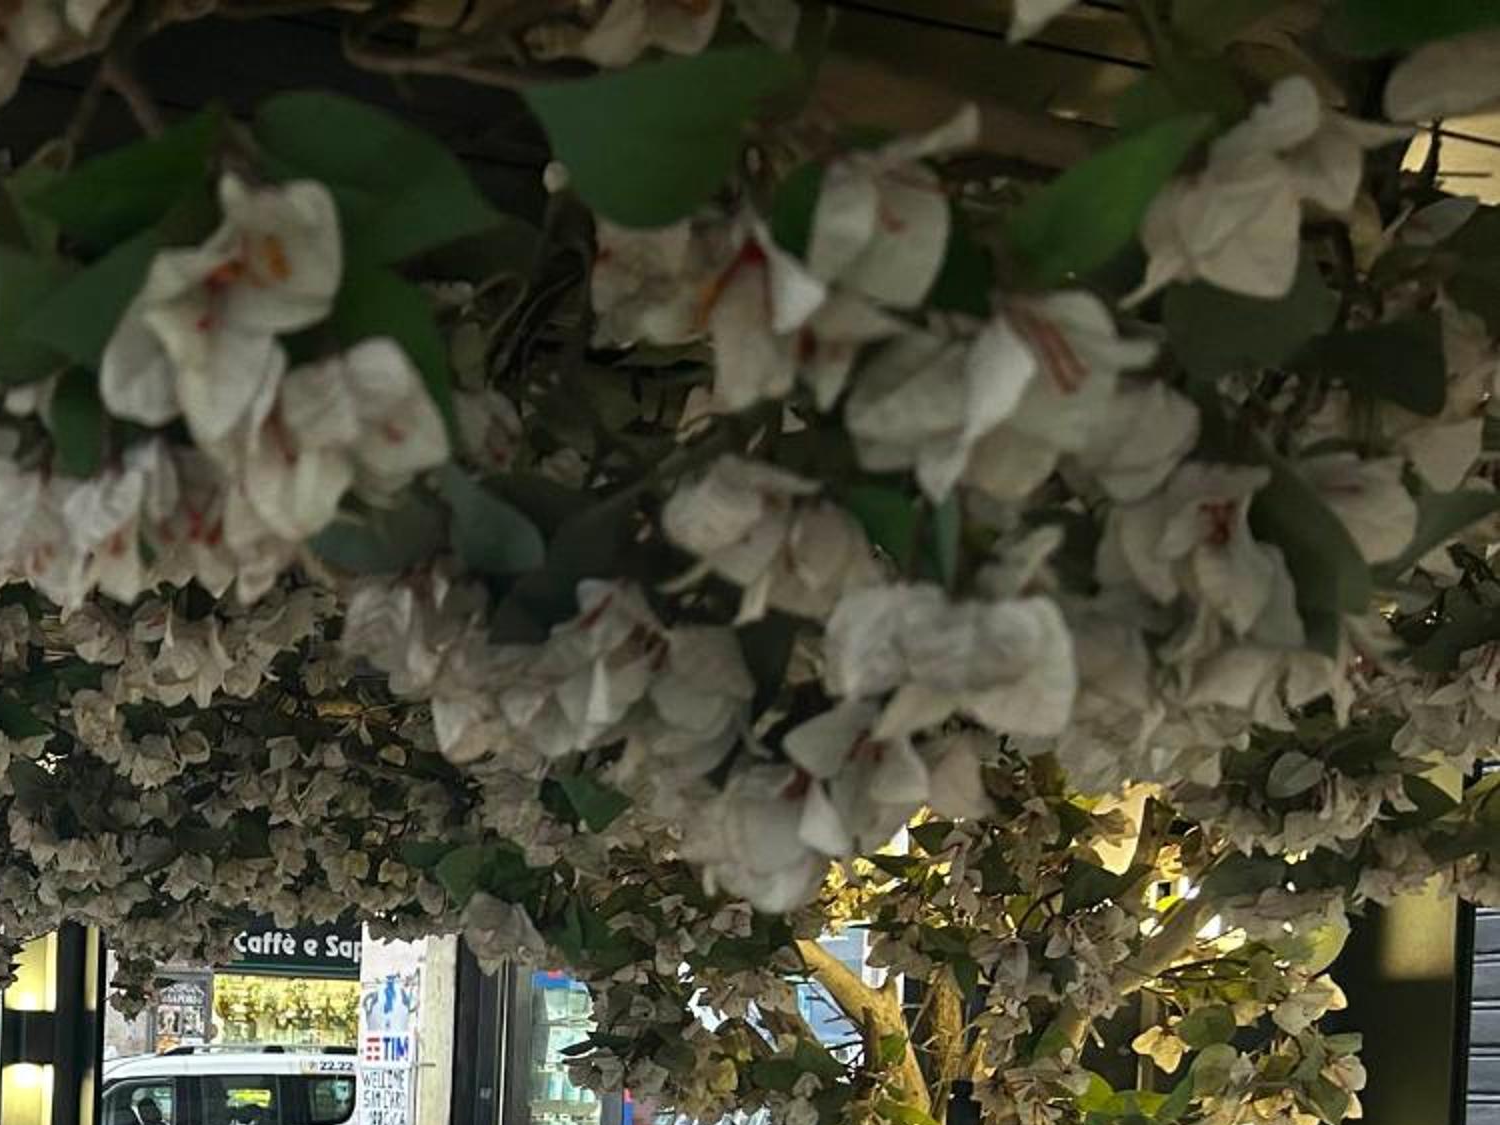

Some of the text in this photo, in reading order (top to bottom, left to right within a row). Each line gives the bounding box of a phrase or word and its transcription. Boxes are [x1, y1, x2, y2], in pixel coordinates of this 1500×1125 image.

[234, 930, 297, 956] Caffè
[303, 938, 319, 957] e
[383, 1036, 409, 1062] TIM
